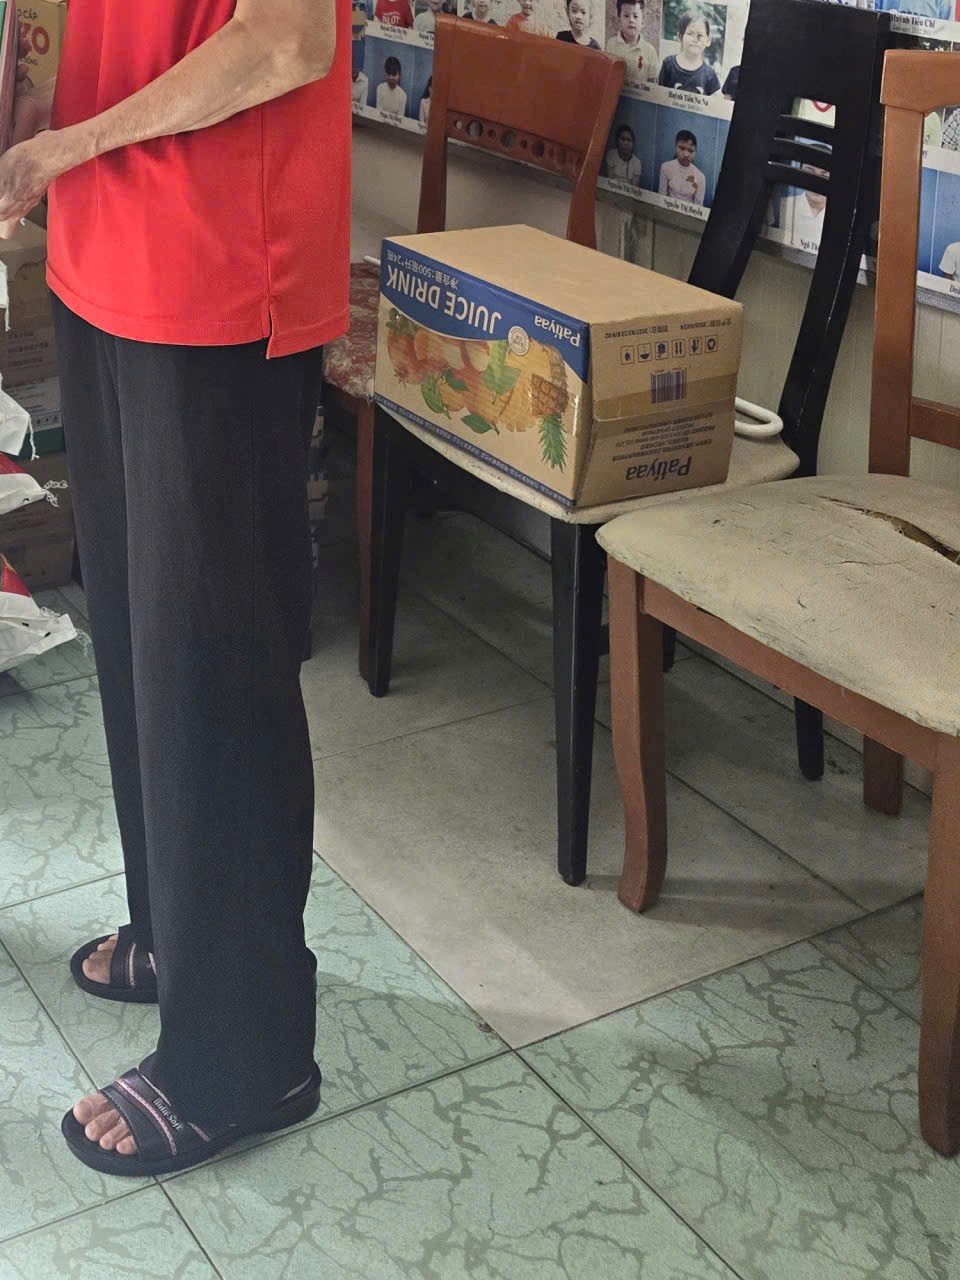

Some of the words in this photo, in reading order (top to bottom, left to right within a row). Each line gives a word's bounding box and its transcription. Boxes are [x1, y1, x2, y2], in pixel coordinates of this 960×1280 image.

[386, 264, 441, 310] DRINK
[444, 290, 502, 335] JUICE
[534, 314, 581, 347] Patiyaa
[626, 455, 692, 481] Patiyaa
